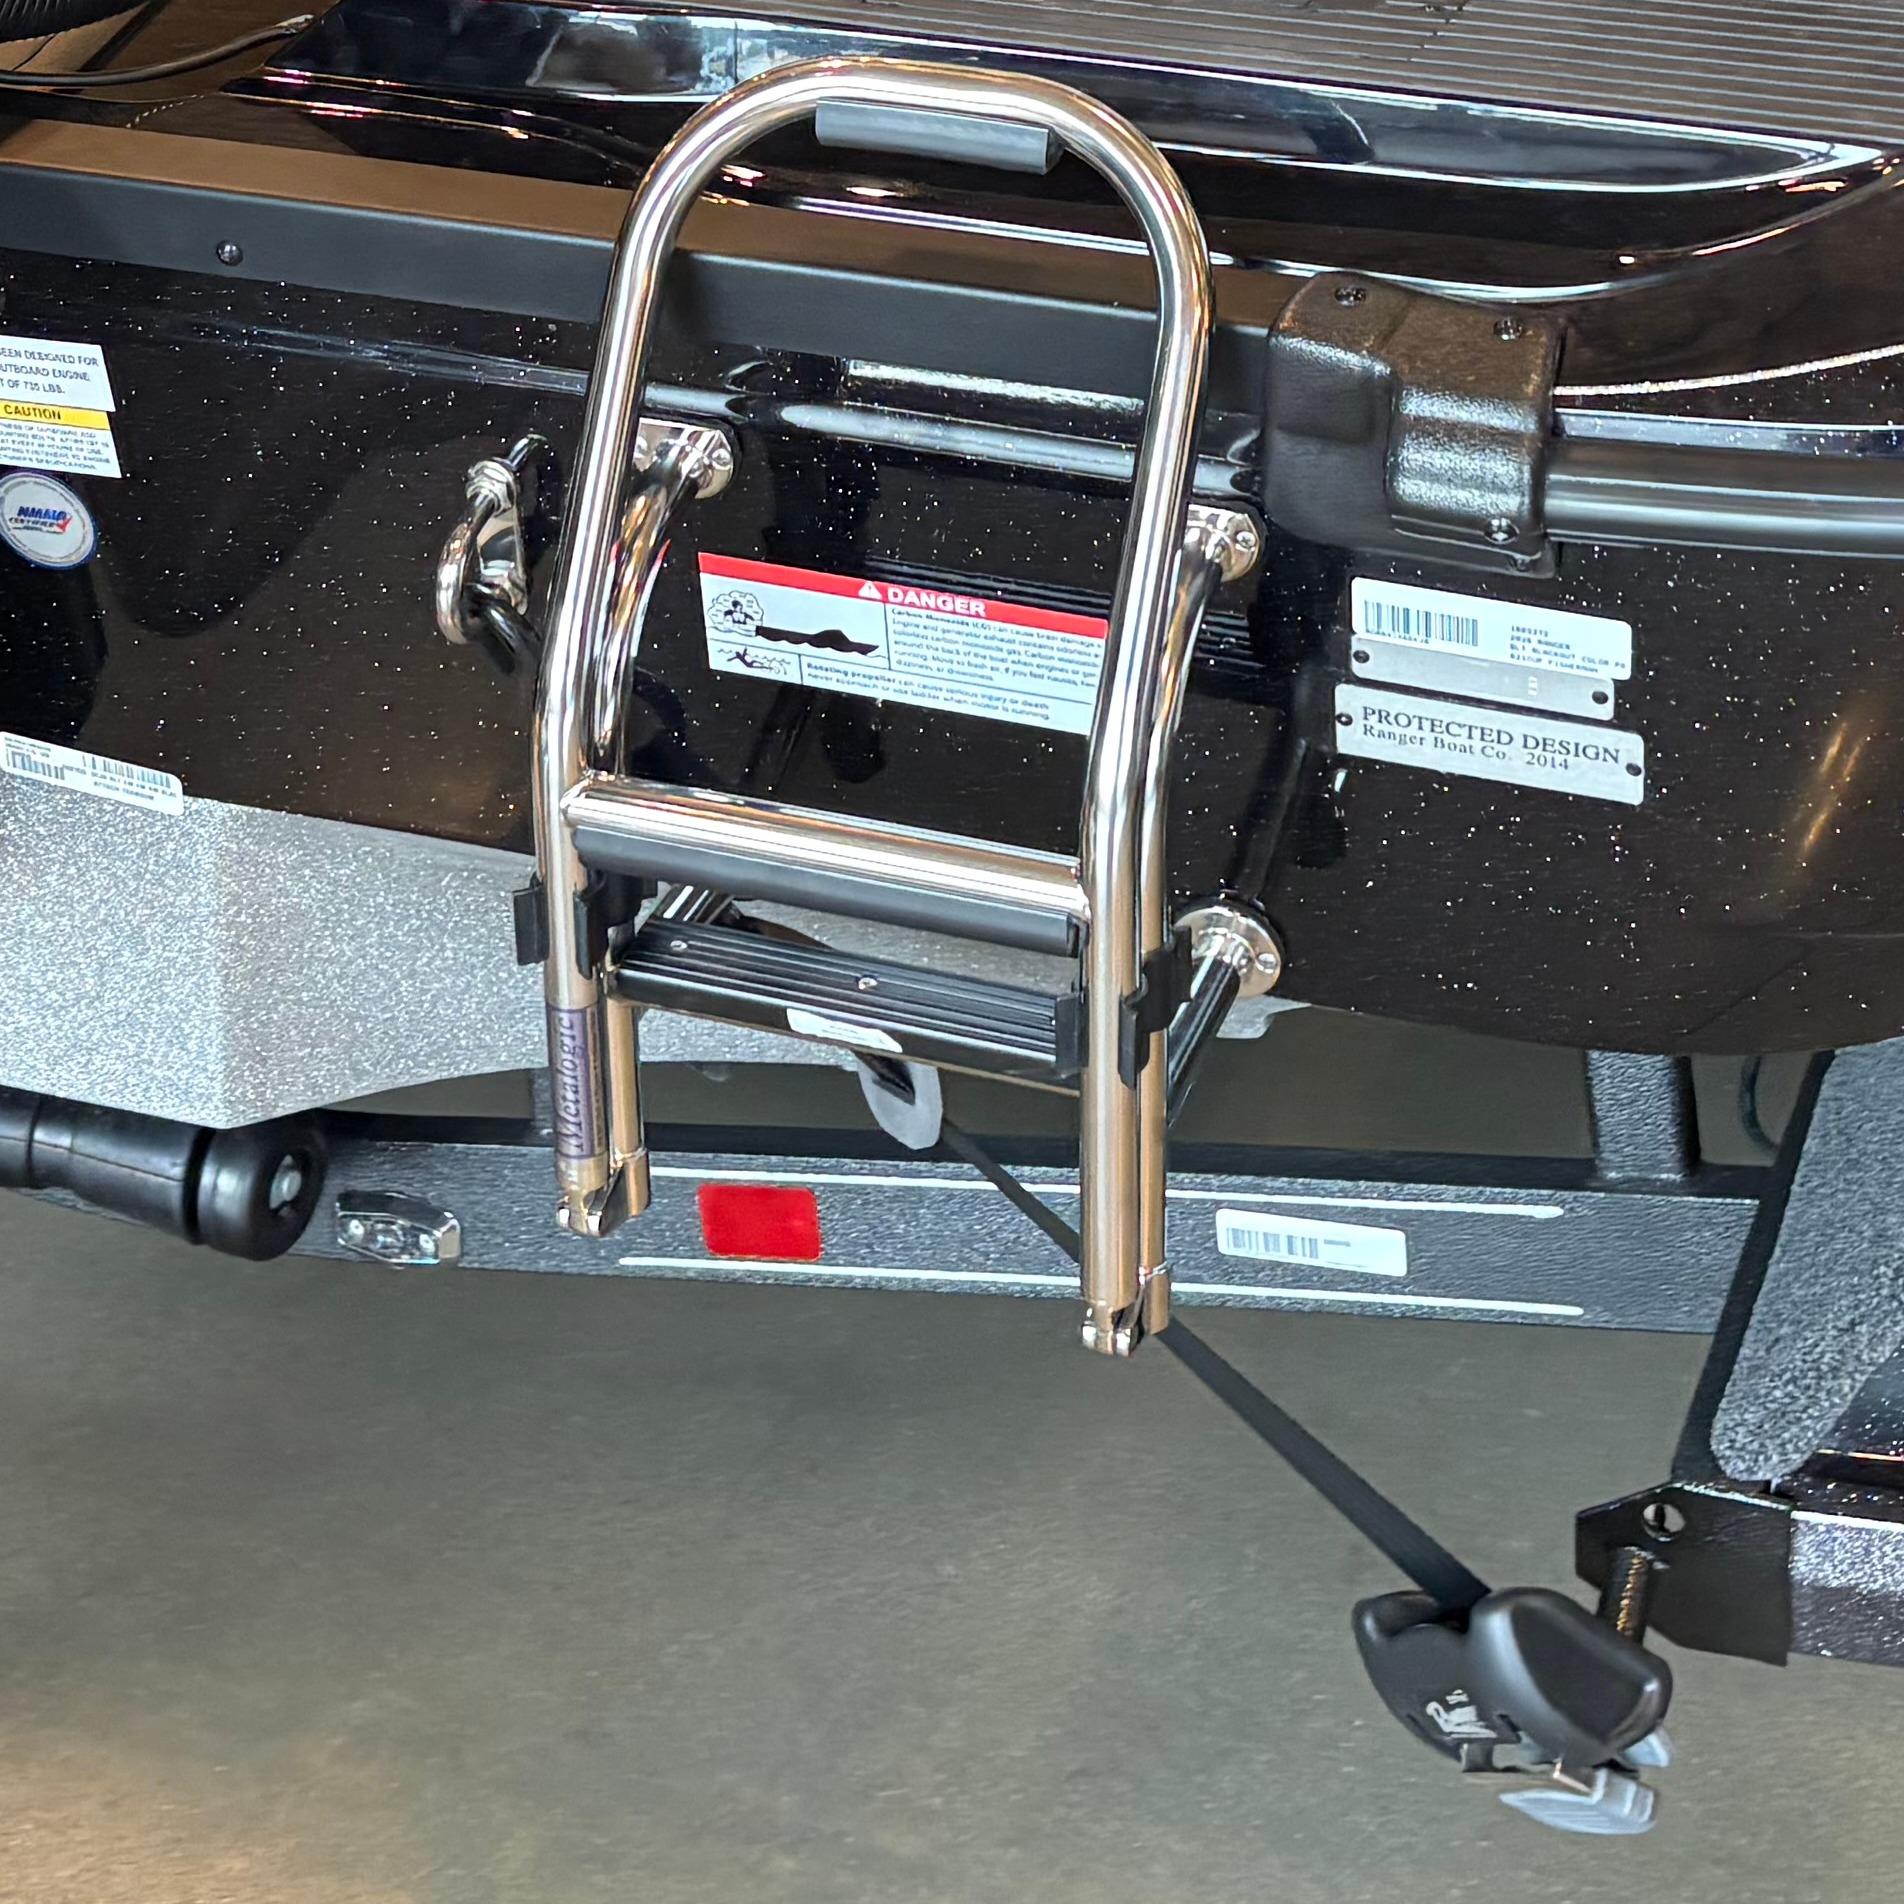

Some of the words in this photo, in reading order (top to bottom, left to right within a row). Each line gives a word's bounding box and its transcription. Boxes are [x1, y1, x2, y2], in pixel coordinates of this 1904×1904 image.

[78, 355, 99, 367] FOR
[7, 379, 20, 389] OF
[3, 403, 61, 421] CAUTION
[887, 587, 986, 617] DANGER
[1362, 705, 1514, 746] PROTECTED
[1522, 733, 1621, 764] DESIGN
[1362, 723, 1425, 747] Ranger
[1433, 736, 1475, 755] Boat
[1480, 745, 1512, 761] Co.
[1525, 752, 1570, 771] 2014
[556, 1015, 586, 1154] Metalogic
